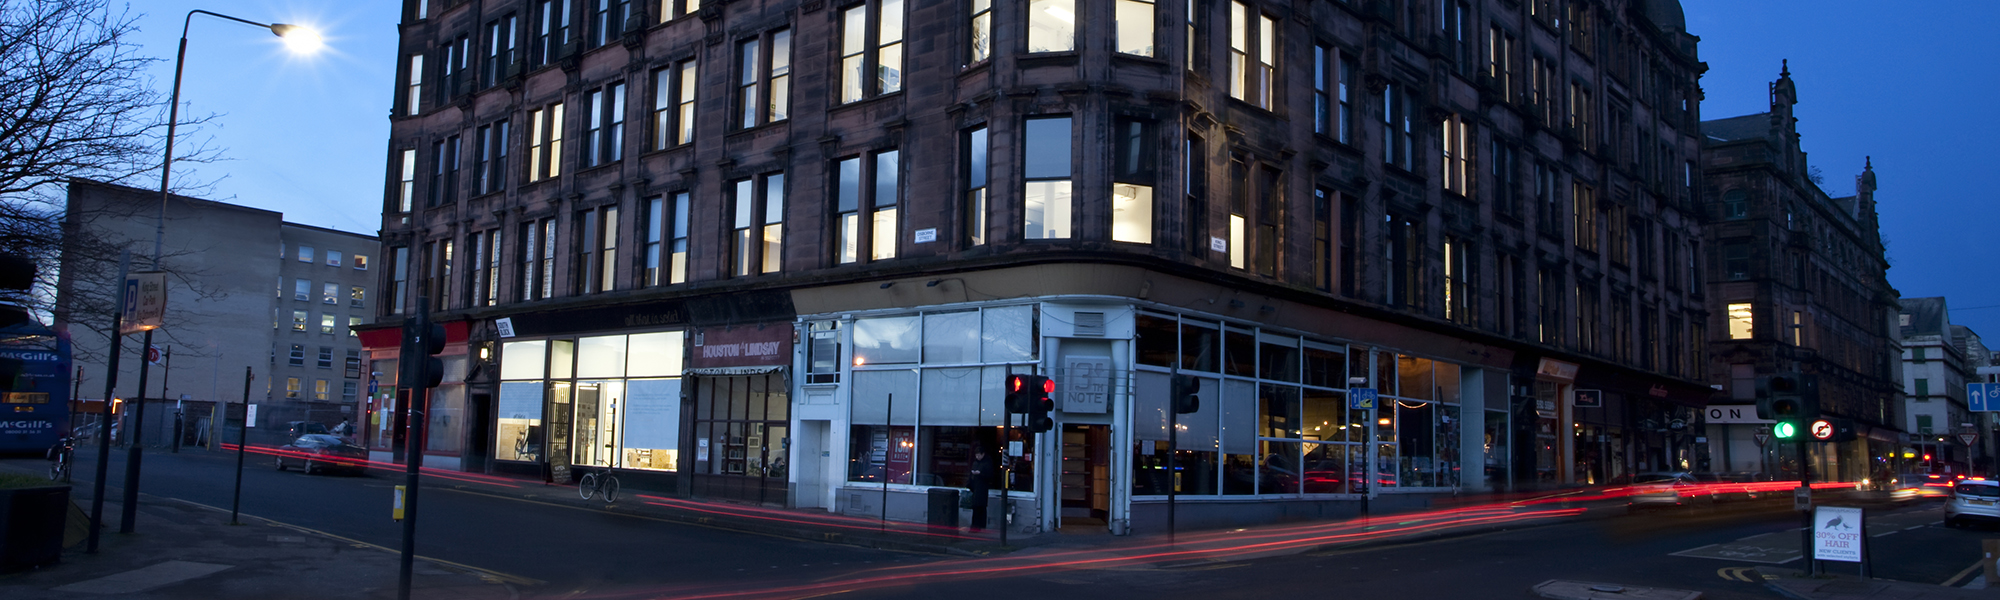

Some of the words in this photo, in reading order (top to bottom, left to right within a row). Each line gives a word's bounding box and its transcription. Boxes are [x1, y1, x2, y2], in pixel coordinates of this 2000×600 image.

[703, 343, 739, 358] HOUSTON
[745, 341, 780, 356] LINDSAY
[1068, 392, 1103, 403] NOTE
[1816, 531, 1836, 539] 30%
[1825, 540, 1850, 548] HAIR
